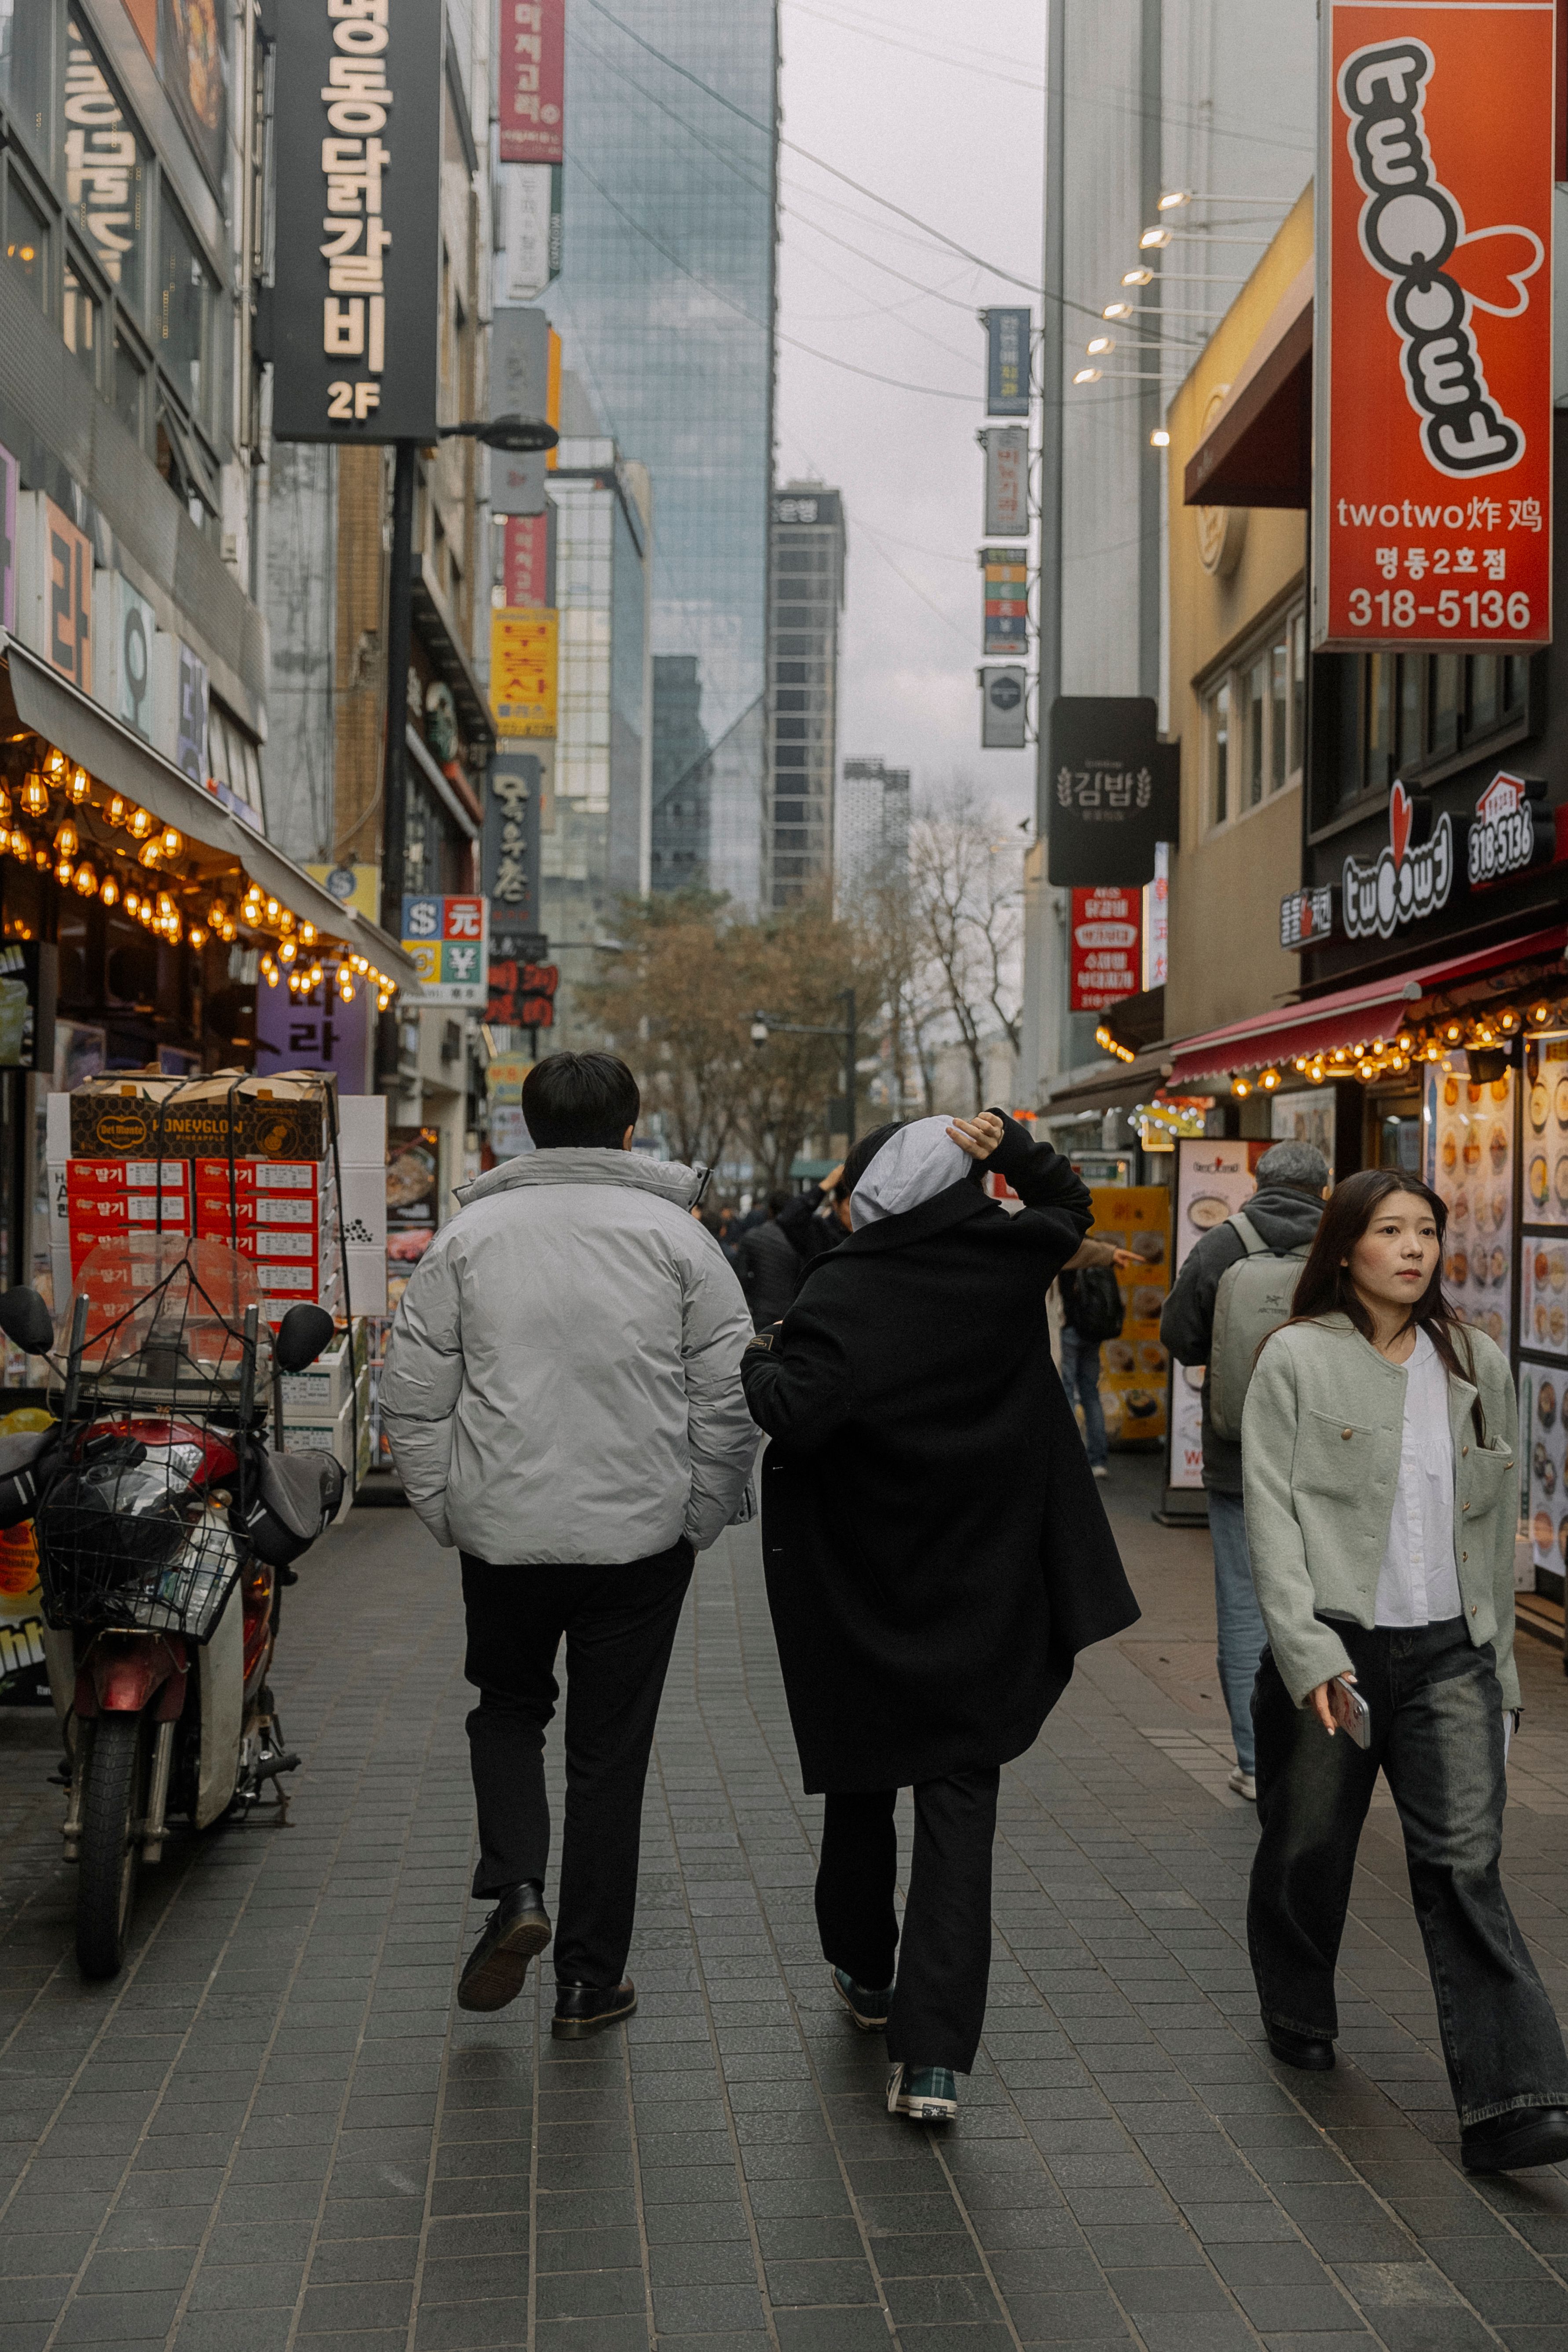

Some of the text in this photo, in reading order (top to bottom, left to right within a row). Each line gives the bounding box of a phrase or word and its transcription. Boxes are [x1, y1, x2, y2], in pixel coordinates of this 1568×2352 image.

[327, 381, 380, 419] 2F
[1375, 547, 1506, 581] 명동2호점
[1348, 588, 1531, 630] 318-5136
[1074, 771, 1134, 807] 김밥
[1470, 811, 1530, 875] 318-5136
[409, 902, 479, 935] $ 元
[448, 947, 477, 979] ¥
[100, 1125, 114, 1135] Del
[95, 1167, 123, 1183] 딸기
[96, 1201, 124, 1217] 딸기
